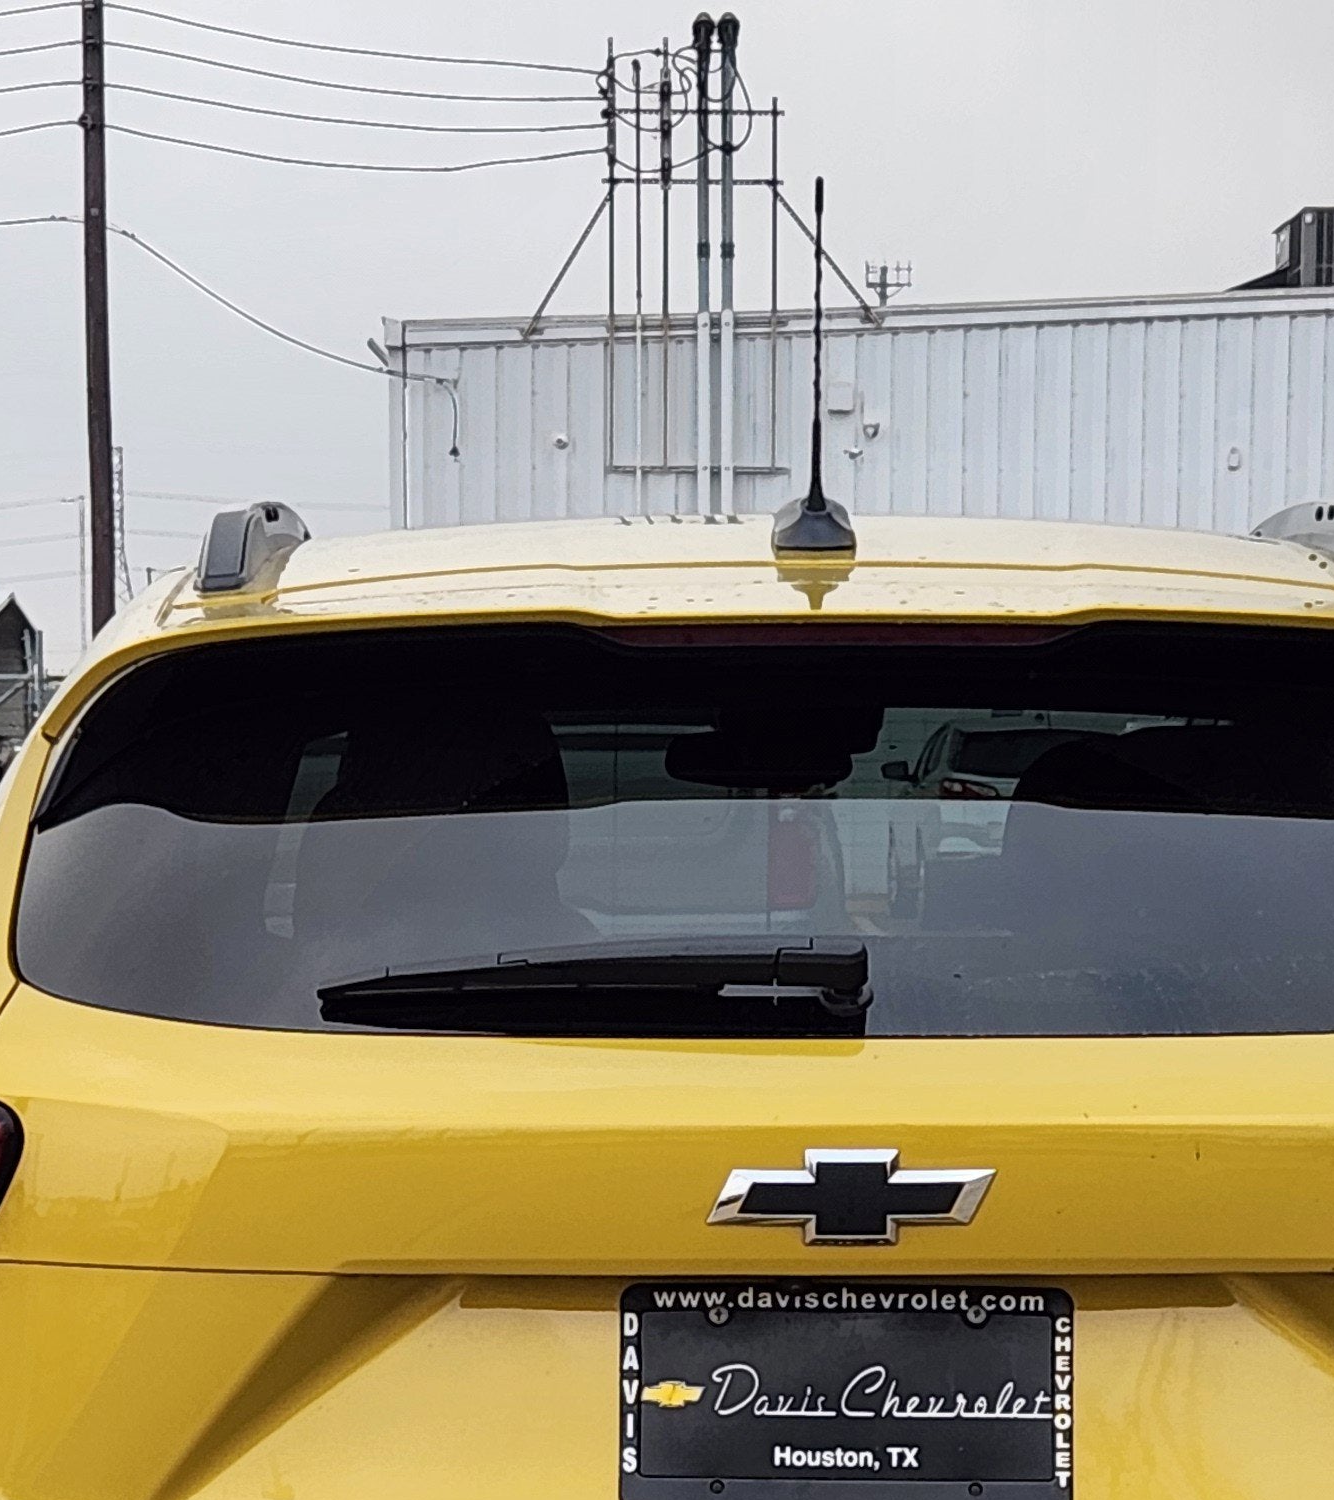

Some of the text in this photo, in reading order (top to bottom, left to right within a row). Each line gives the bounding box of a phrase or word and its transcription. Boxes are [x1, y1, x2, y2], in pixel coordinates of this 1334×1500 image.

[653, 1286, 1045, 1312] www.davischevroletcom
[622, 1312, 640, 1474] DAVIS
[711, 1363, 1053, 1418] Davis Chevrolet
[1054, 1316, 1072, 1489] CHEVROLET
[773, 1445, 920, 1472] Houston, TX
